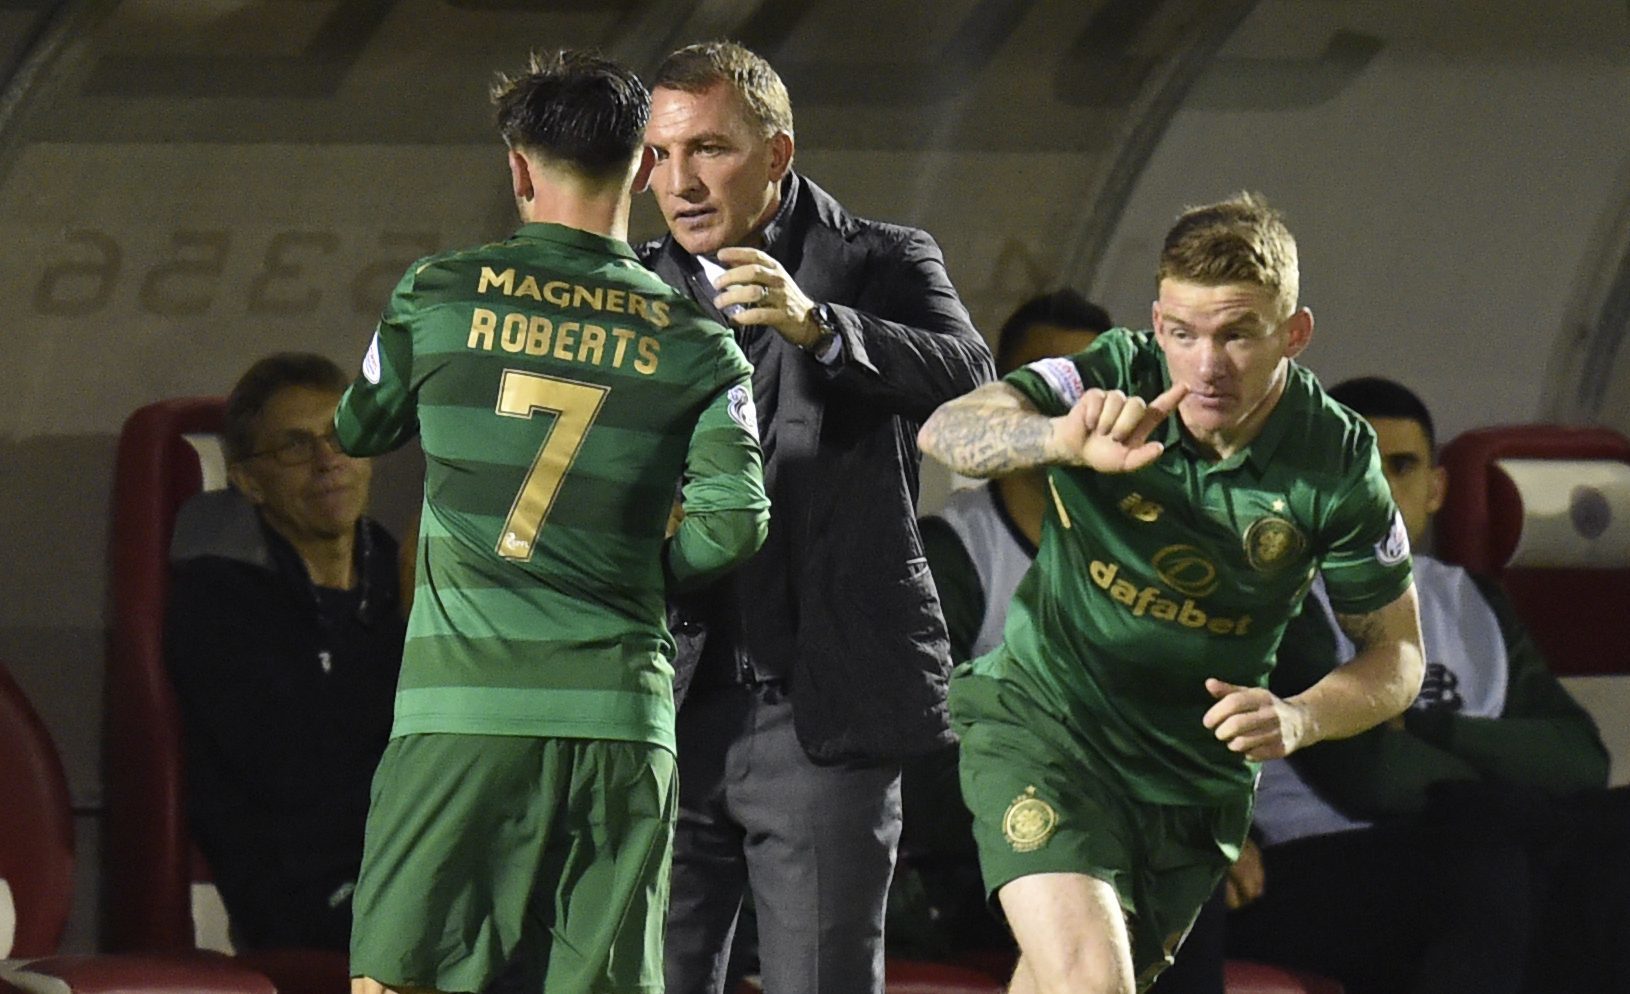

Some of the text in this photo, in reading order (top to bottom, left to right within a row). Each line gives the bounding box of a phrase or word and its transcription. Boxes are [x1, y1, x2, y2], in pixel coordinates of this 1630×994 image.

[477, 266, 672, 329] MAGNERS
[466, 307, 661, 375] ROBERTS
[495, 368, 612, 562] 7
[1089, 559, 1253, 636] dafabet
